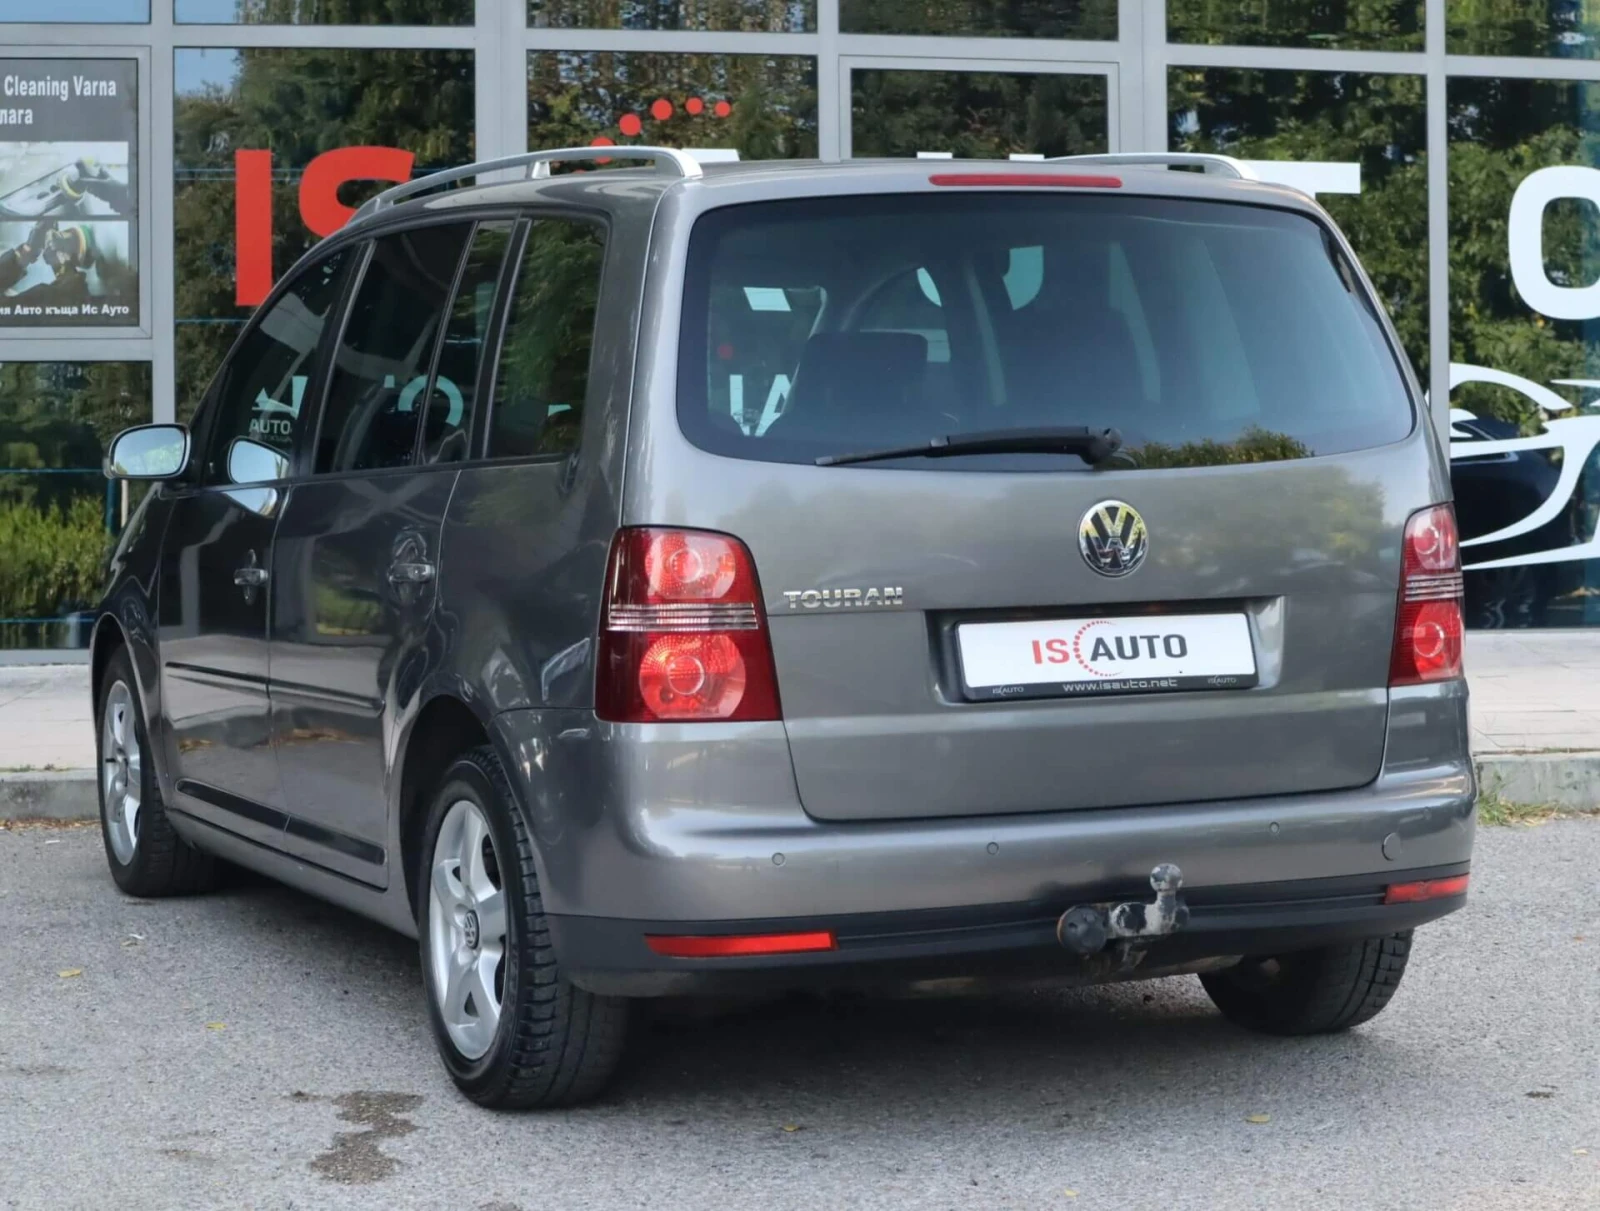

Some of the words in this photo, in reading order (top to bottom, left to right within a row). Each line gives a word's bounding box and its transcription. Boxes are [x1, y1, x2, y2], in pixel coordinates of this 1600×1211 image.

[4, 75, 69, 101] Cleaning
[73, 75, 117, 96] Varna
[14, 304, 42, 315] Авто
[249, 418, 291, 435] AUTO
[783, 587, 903, 609] TOURAN
[1089, 633, 1188, 662] AUTO
[1062, 678, 1178, 692] www.isauto.net
